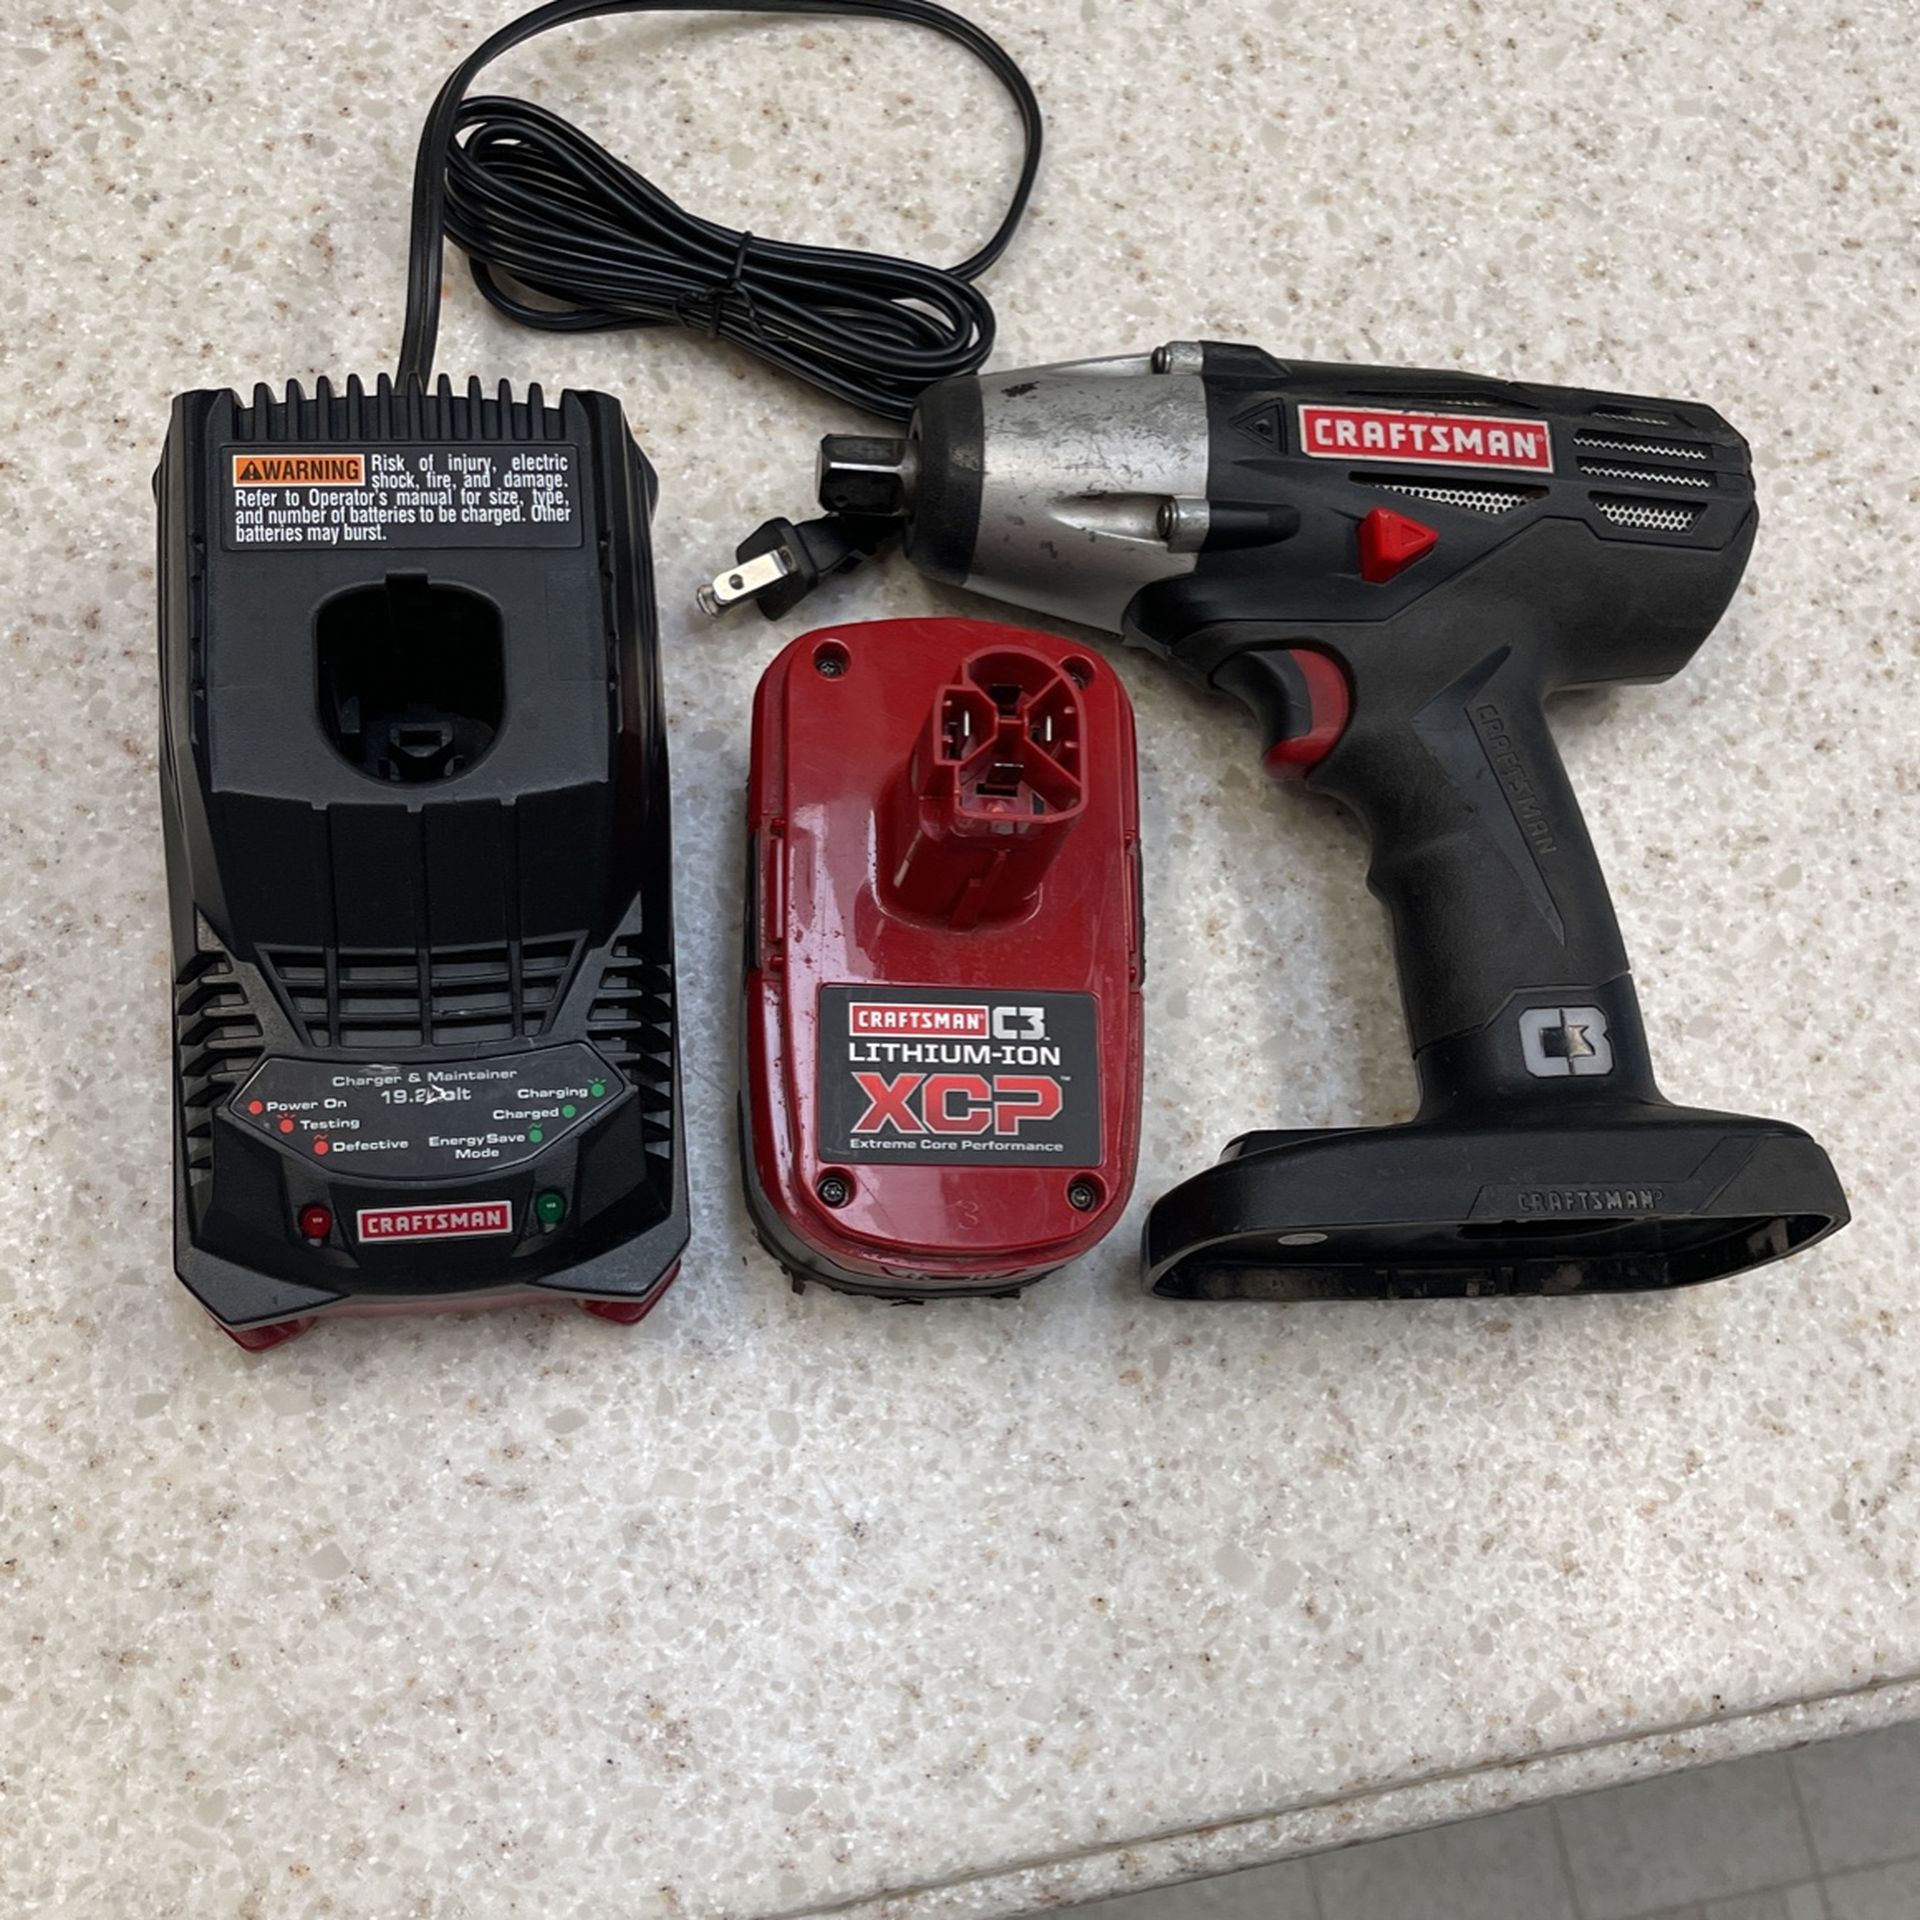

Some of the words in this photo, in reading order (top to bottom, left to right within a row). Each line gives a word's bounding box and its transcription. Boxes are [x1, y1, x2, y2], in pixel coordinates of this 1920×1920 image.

[261, 460, 359, 480] WARNING
[371, 454, 406, 471] Risk
[419, 453, 434, 471] of
[448, 453, 496, 474] injury,
[511, 453, 568, 471] electric
[371, 471, 420, 490] shock,
[426, 471, 457, 490] fire,
[463, 471, 491, 488] and
[503, 471, 568, 490] damage.
[235, 489, 277, 506] Refer
[285, 489, 300, 506] to
[309, 488, 388, 508] Operator's
[396, 488, 452, 506] manual
[460, 488, 481, 505] for
[489, 488, 524, 507] size,
[532, 488, 569, 508] type,
[235, 507, 263, 524] and
[268, 506, 326, 524] number
[331, 506, 346, 523] of
[350, 505, 416, 523] batteries
[420, 505, 434, 523] to
[438, 505, 457, 522] be
[461, 505, 526, 526] charged.
[531, 504, 571, 522] Other
[236, 525, 302, 542] batteries
[307, 526, 340, 545] may
[344, 523, 387, 541] burst.
[1476, 704, 1557, 856] CRAFTSMAN
[857, 1010, 981, 1030] CRAFTSMAN
[849, 1042, 1061, 1066] LITHIUM-ION
[332, 1075, 402, 1088] Charger
[408, 1072, 421, 1083] &
[427, 1069, 517, 1082] Maintainer
[381, 1087, 427, 1104] 19.2
[517, 1086, 589, 1100] Charging
[266, 1101, 319, 1112] Power
[324, 1097, 347, 1109] On
[850, 1071, 1063, 1136] XCP
[492, 1107, 559, 1120] Charged
[300, 1118, 360, 1131] Testing
[332, 1139, 408, 1152] Defective
[455, 1148, 500, 1159] Mode
[850, 1138, 917, 1149] Extreme
[920, 1139, 958, 1150] Core
[961, 1139, 1064, 1152] Performance
[366, 1209, 501, 1236] CRAFTSMAN
